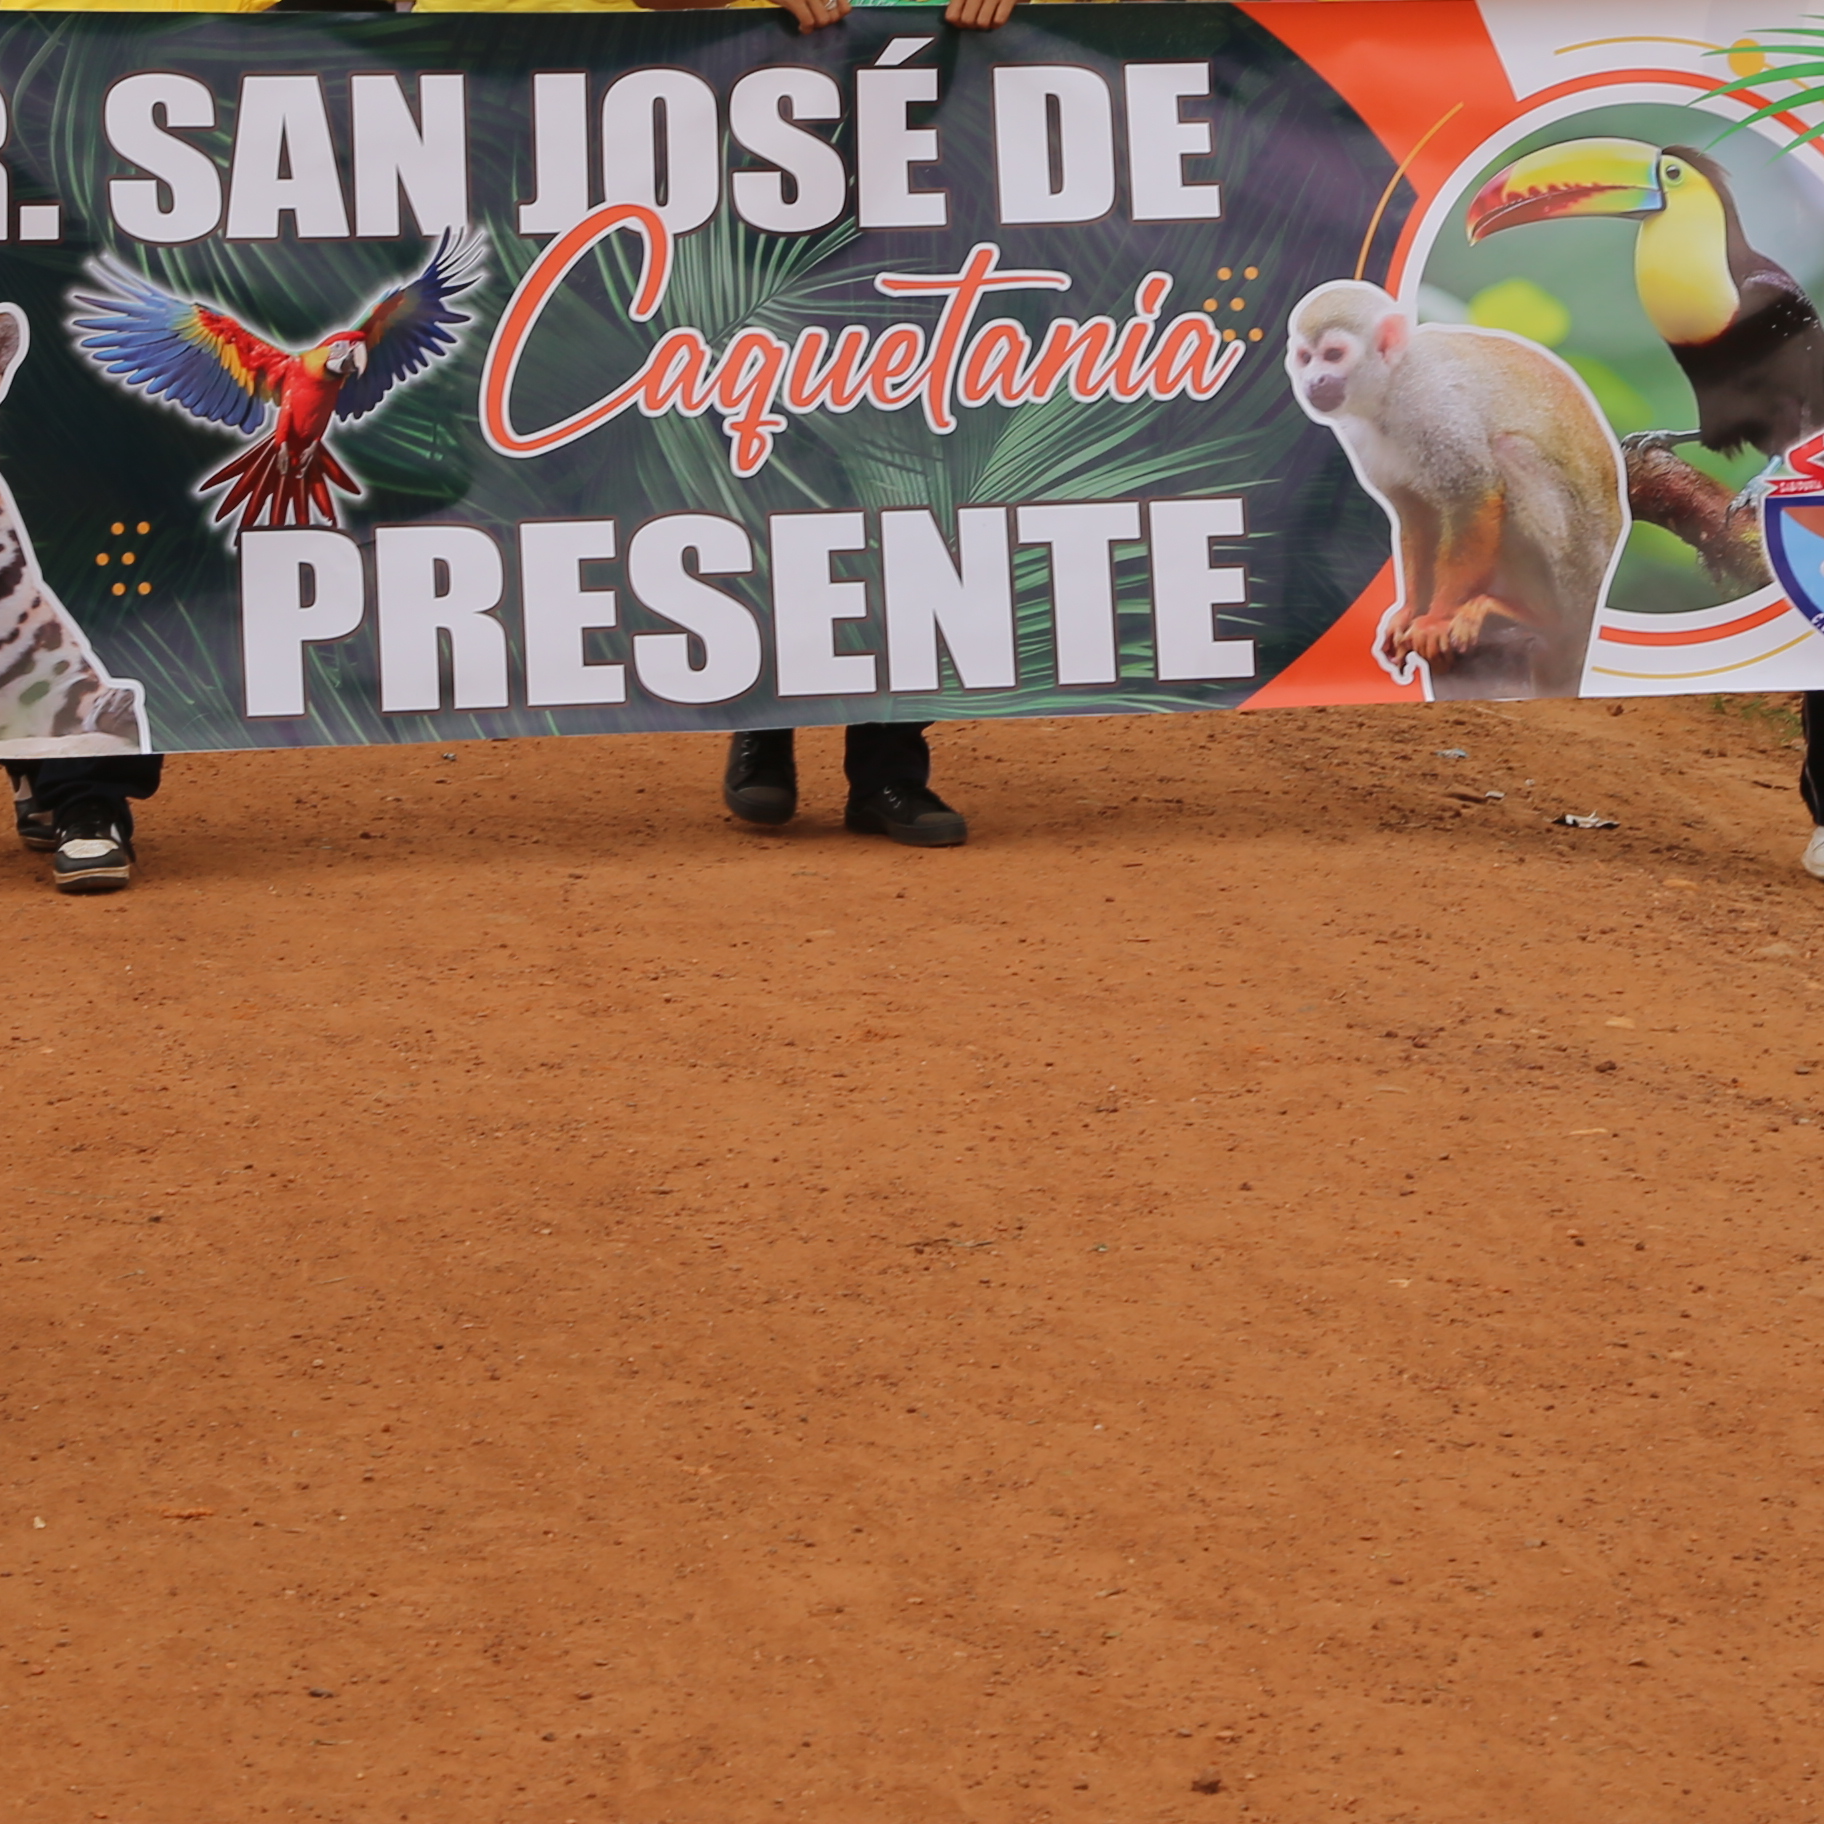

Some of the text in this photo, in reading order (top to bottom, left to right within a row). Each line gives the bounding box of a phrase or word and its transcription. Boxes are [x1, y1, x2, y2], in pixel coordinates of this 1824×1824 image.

[104, 72, 469, 243] SAN
[518, 36, 948, 236] JOSÉ
[992, 62, 1221, 225] DE
[481, 201, 1242, 476] Caquetania
[239, 497, 1256, 717] PRESENTE
